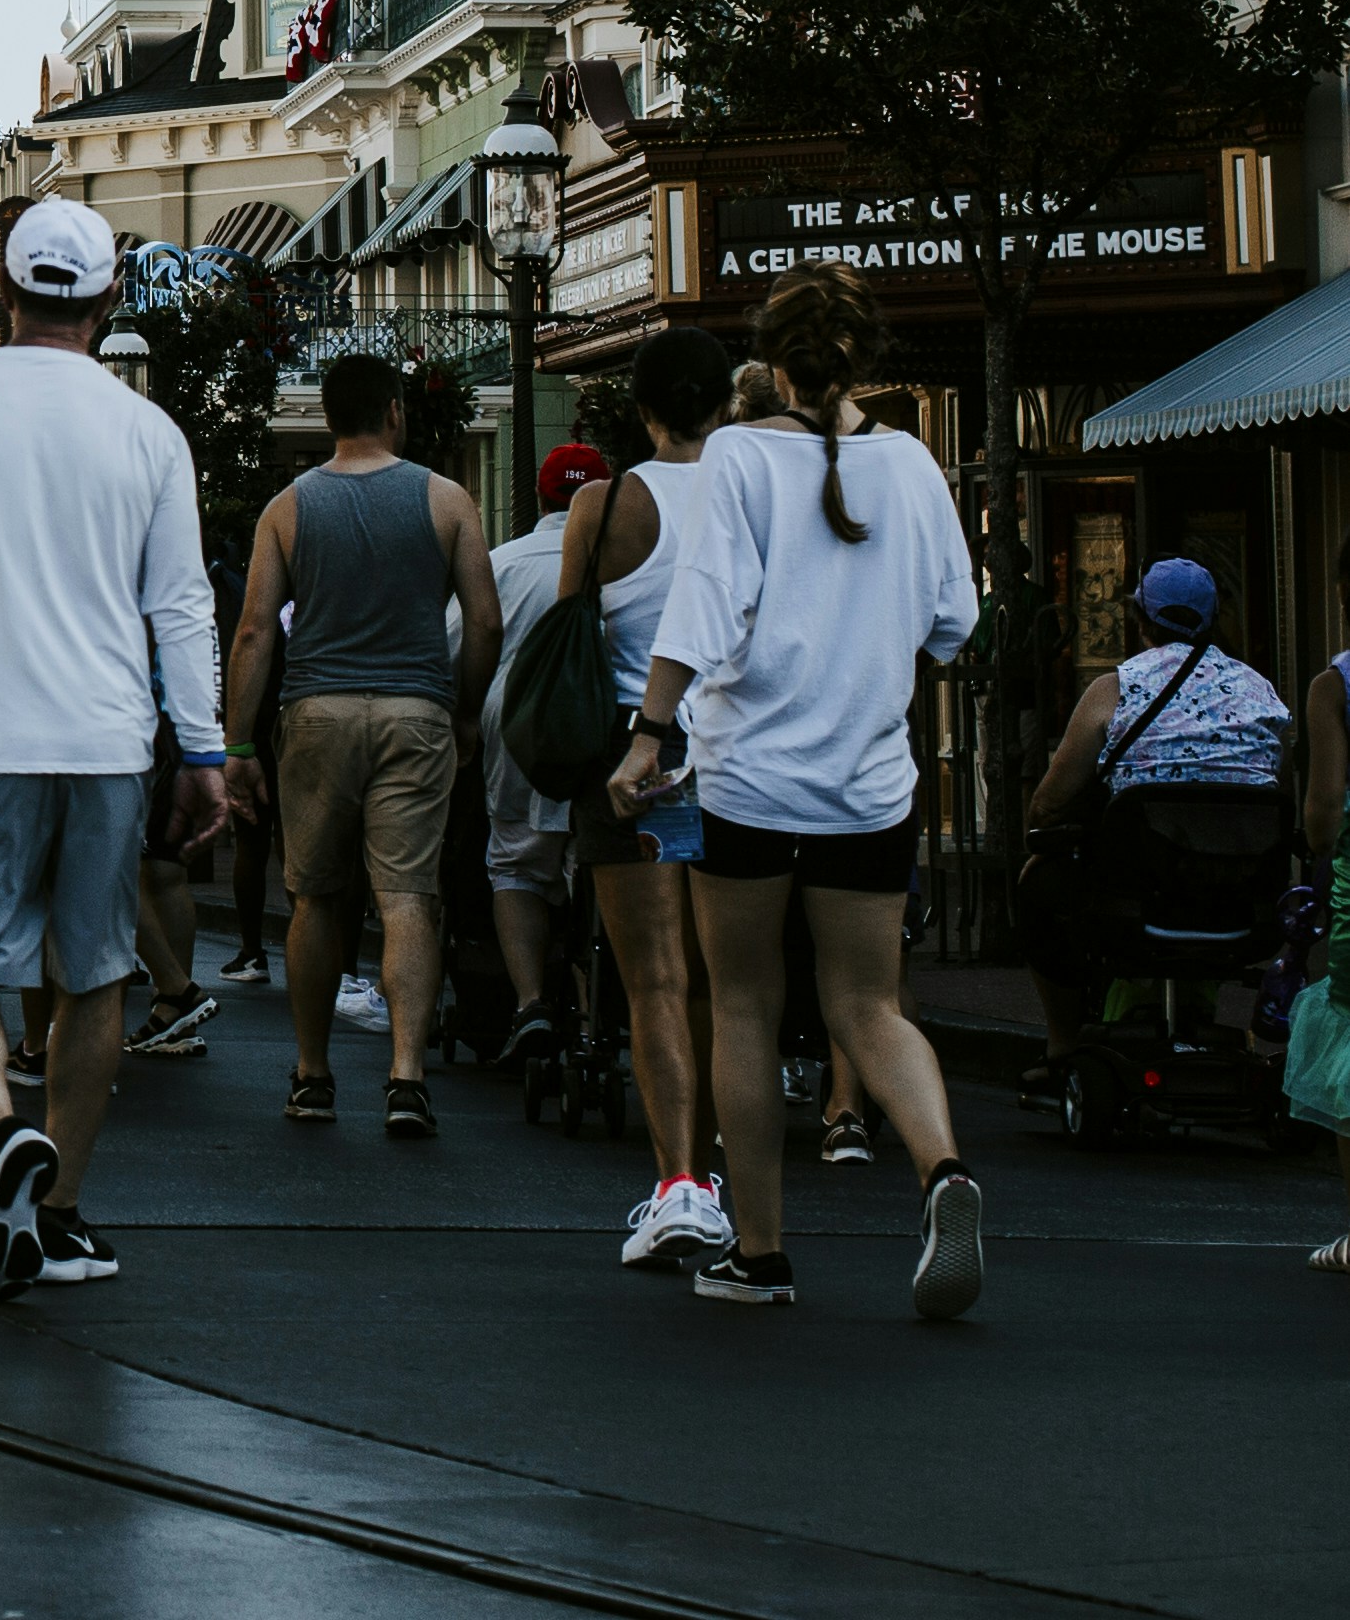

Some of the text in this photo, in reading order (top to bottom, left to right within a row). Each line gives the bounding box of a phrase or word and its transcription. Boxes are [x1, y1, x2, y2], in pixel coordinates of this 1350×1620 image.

[787, 202, 843, 228] THE
[720, 251, 742, 275] A
[1097, 226, 1207, 256] MOUSE
[565, 470, 586, 480] 1942
